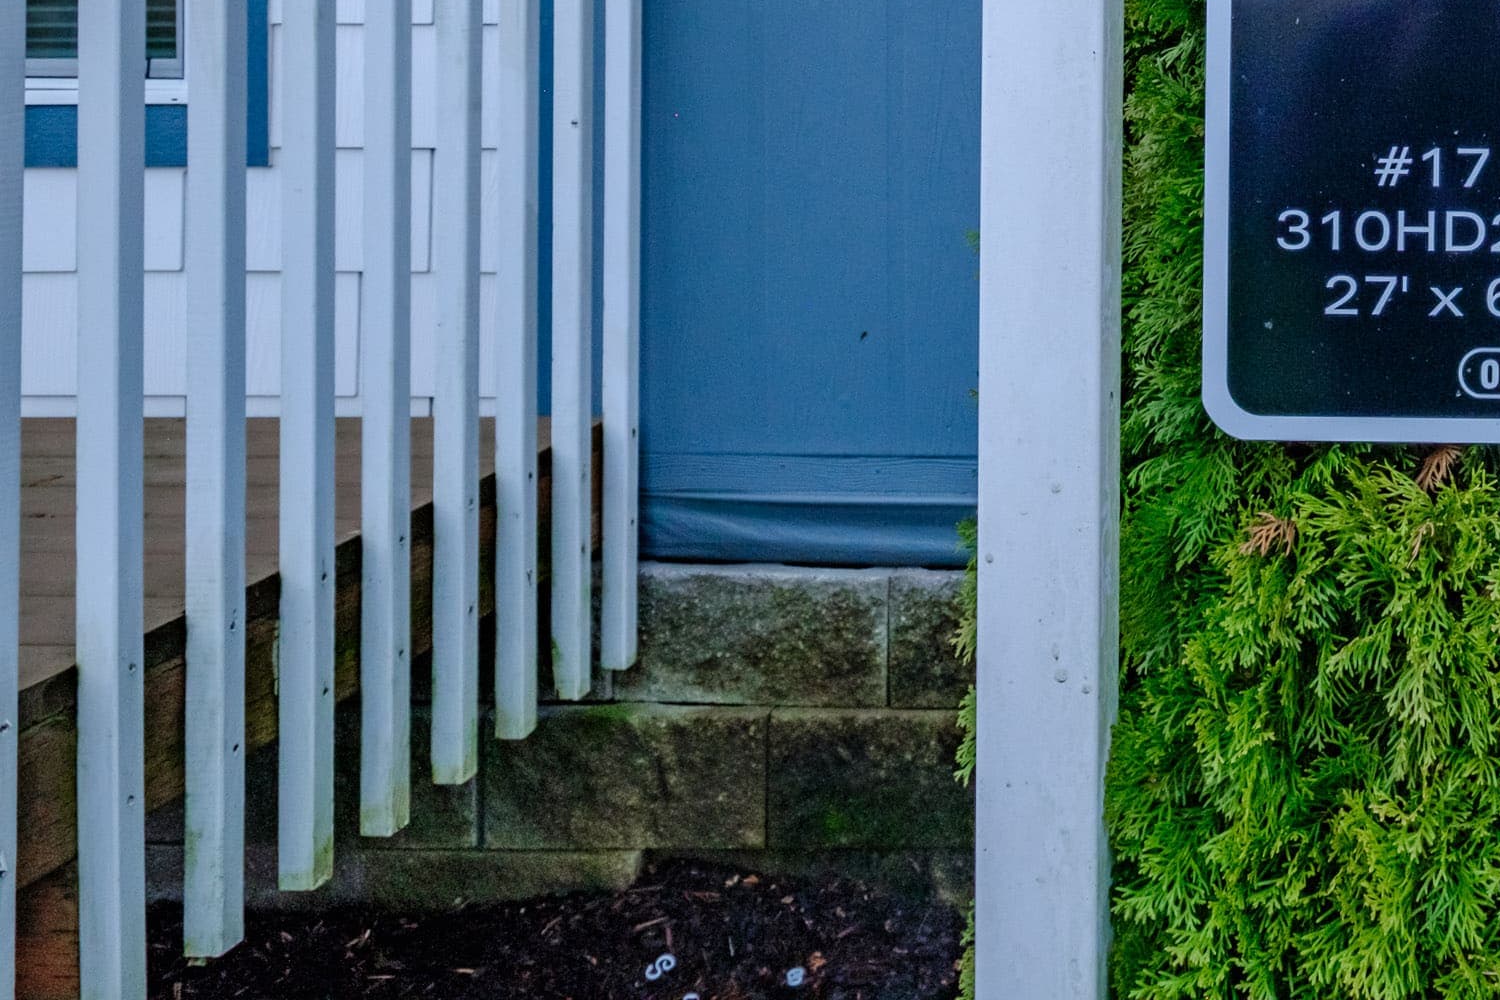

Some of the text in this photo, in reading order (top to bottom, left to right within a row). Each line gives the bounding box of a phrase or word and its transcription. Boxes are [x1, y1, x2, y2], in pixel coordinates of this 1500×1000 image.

[1375, 147, 1489, 187] #17
[1325, 276, 1407, 314] 27'
[1429, 288, 1462, 316] x
